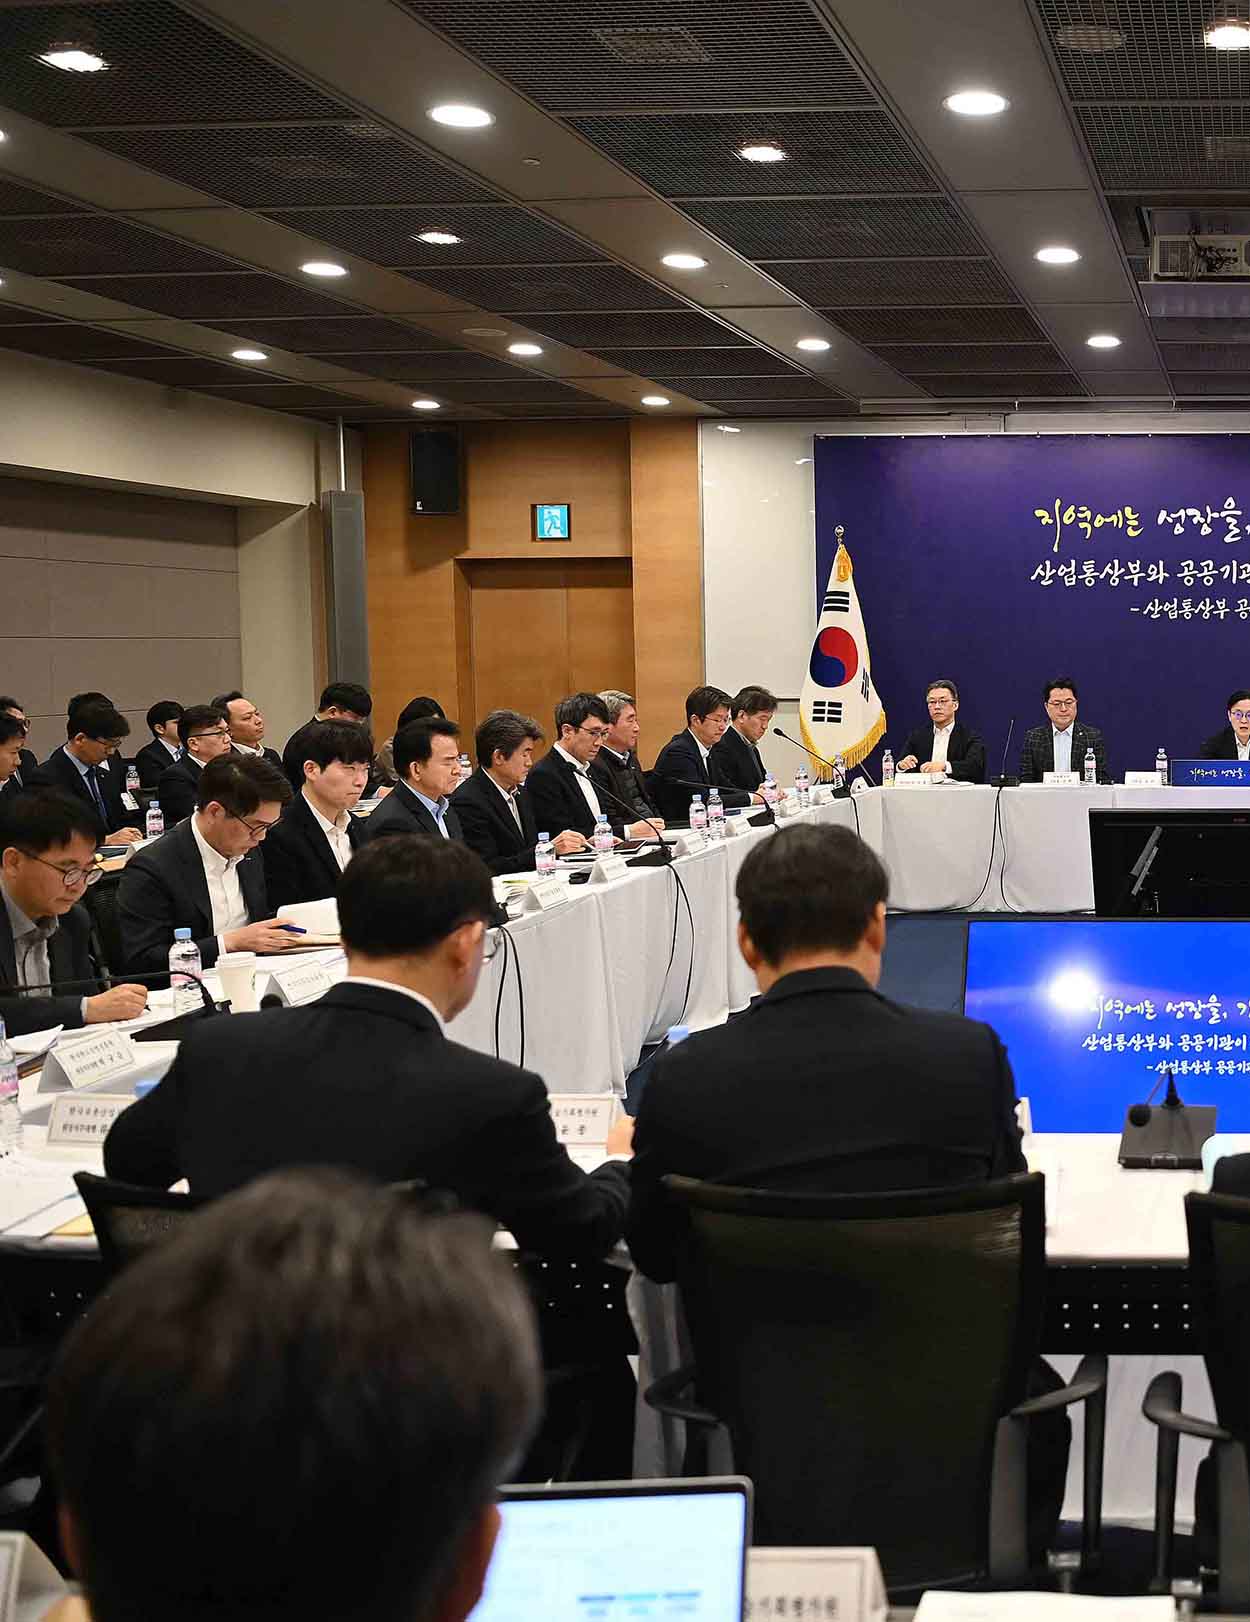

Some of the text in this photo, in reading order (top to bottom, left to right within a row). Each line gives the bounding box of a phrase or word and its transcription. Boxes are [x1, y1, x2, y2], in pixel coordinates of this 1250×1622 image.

[1034, 498, 1144, 553] 지역에는
[1030, 559, 1170, 587] 산업통상부와
[1165, 993, 1228, 1025] 성장을,
[1081, 1032, 1175, 1052] 산업통상부와
[1177, 1033, 1247, 1052] 공공기관이
